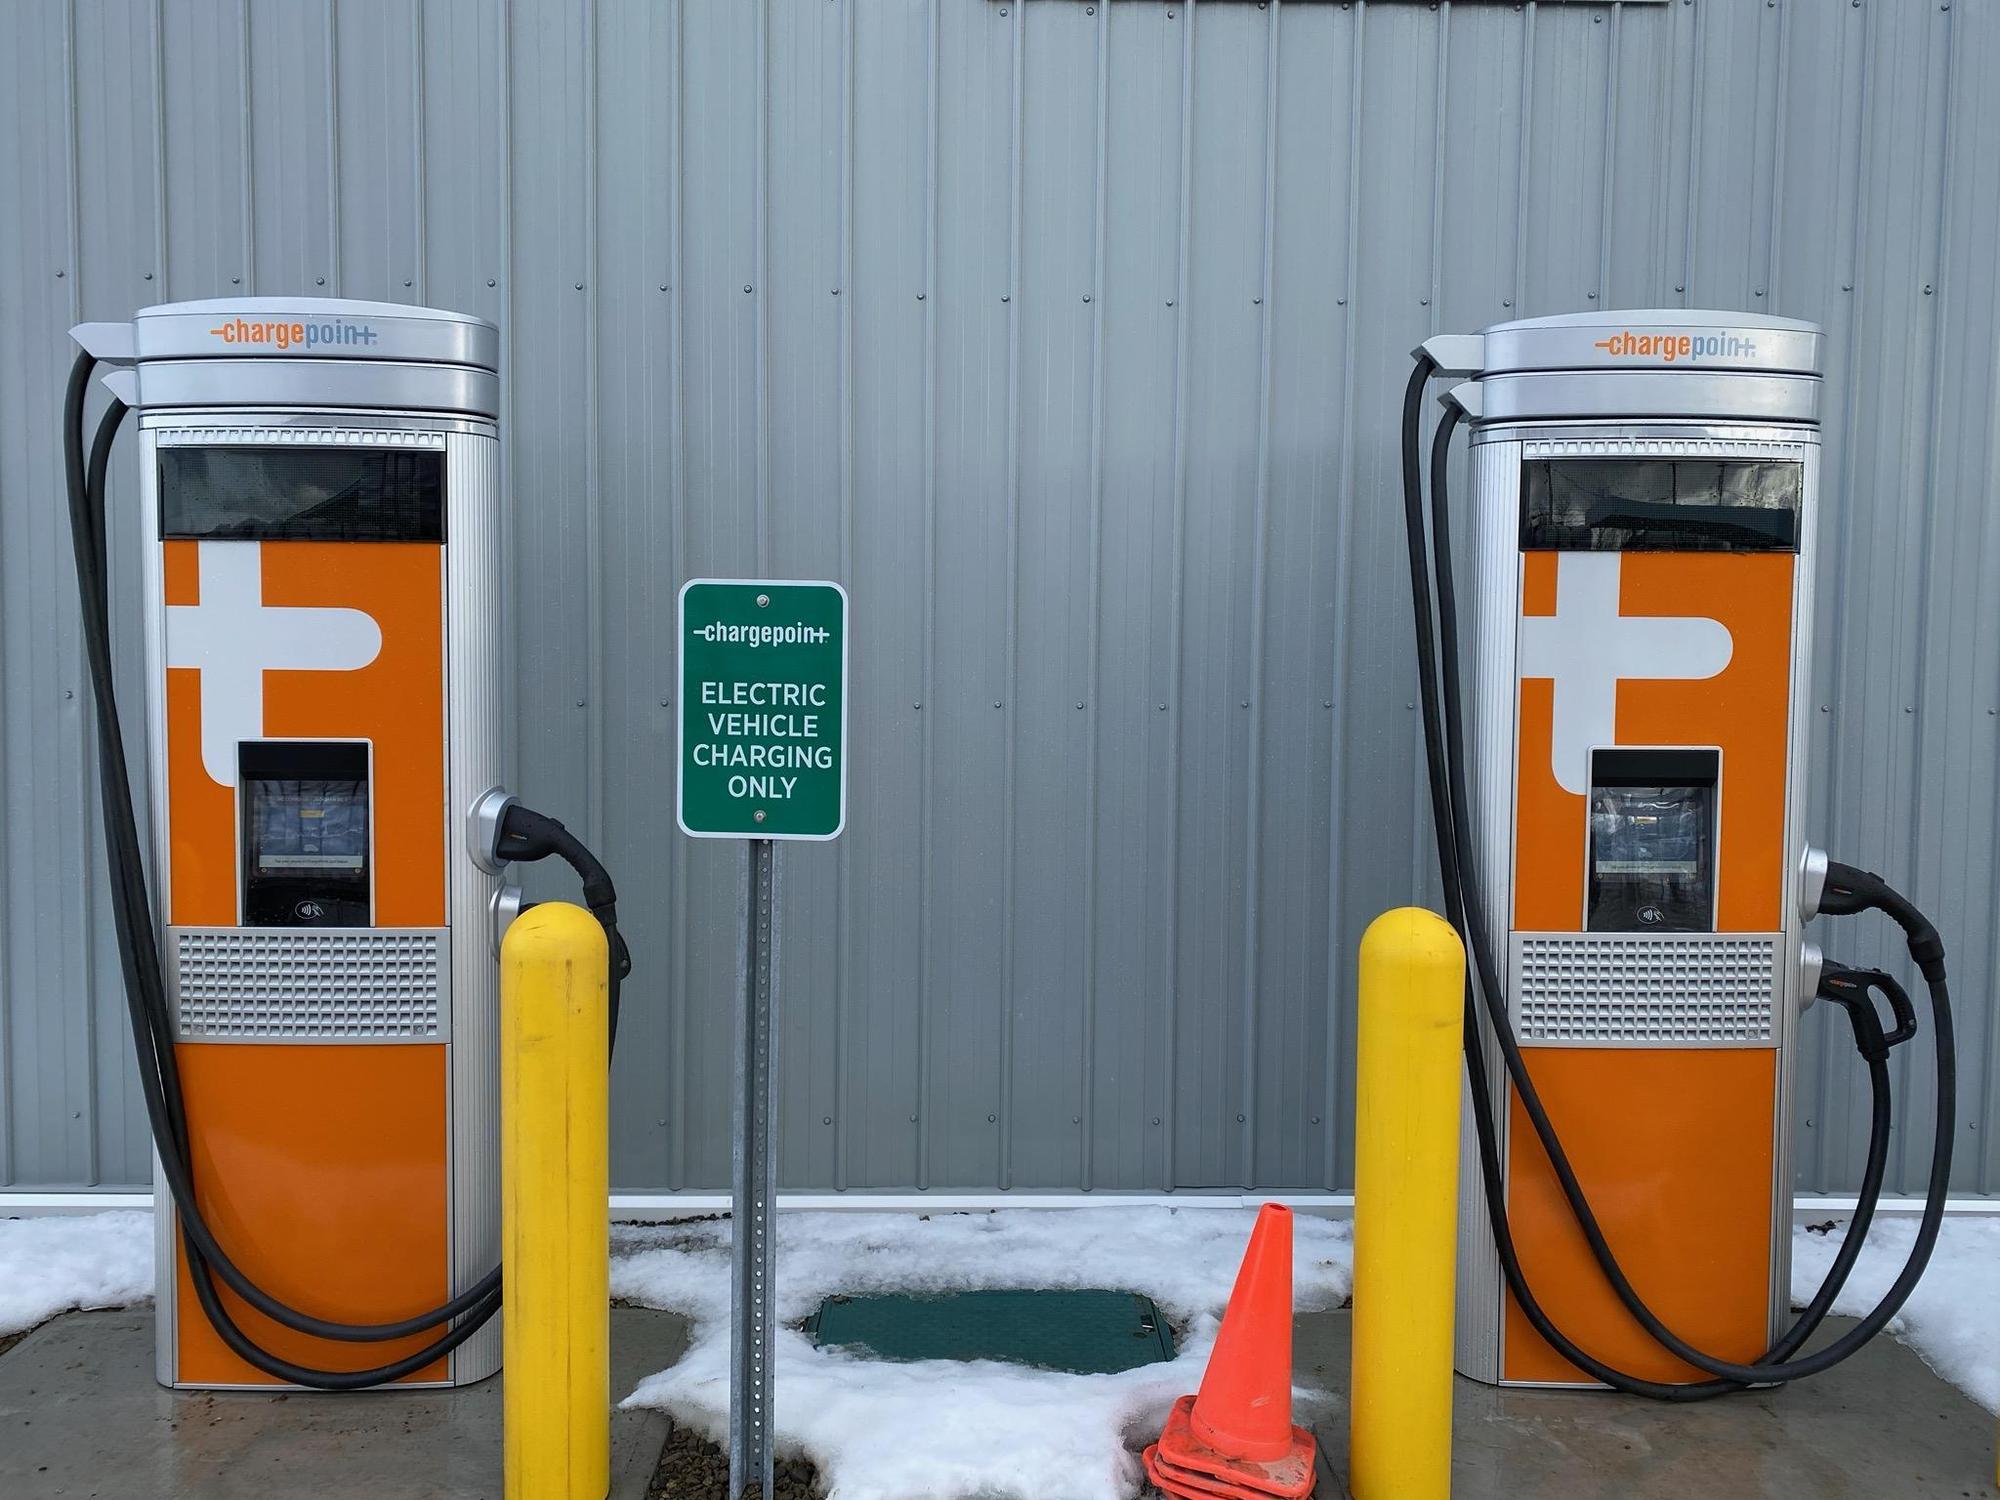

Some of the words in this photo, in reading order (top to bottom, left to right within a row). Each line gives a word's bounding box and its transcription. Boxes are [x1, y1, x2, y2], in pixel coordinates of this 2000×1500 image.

[701, 681, 826, 707] ELECTRIC
[708, 713, 819, 738] VEHICLE
[693, 743, 833, 769] CHARGING
[728, 775, 798, 799] ONLY
